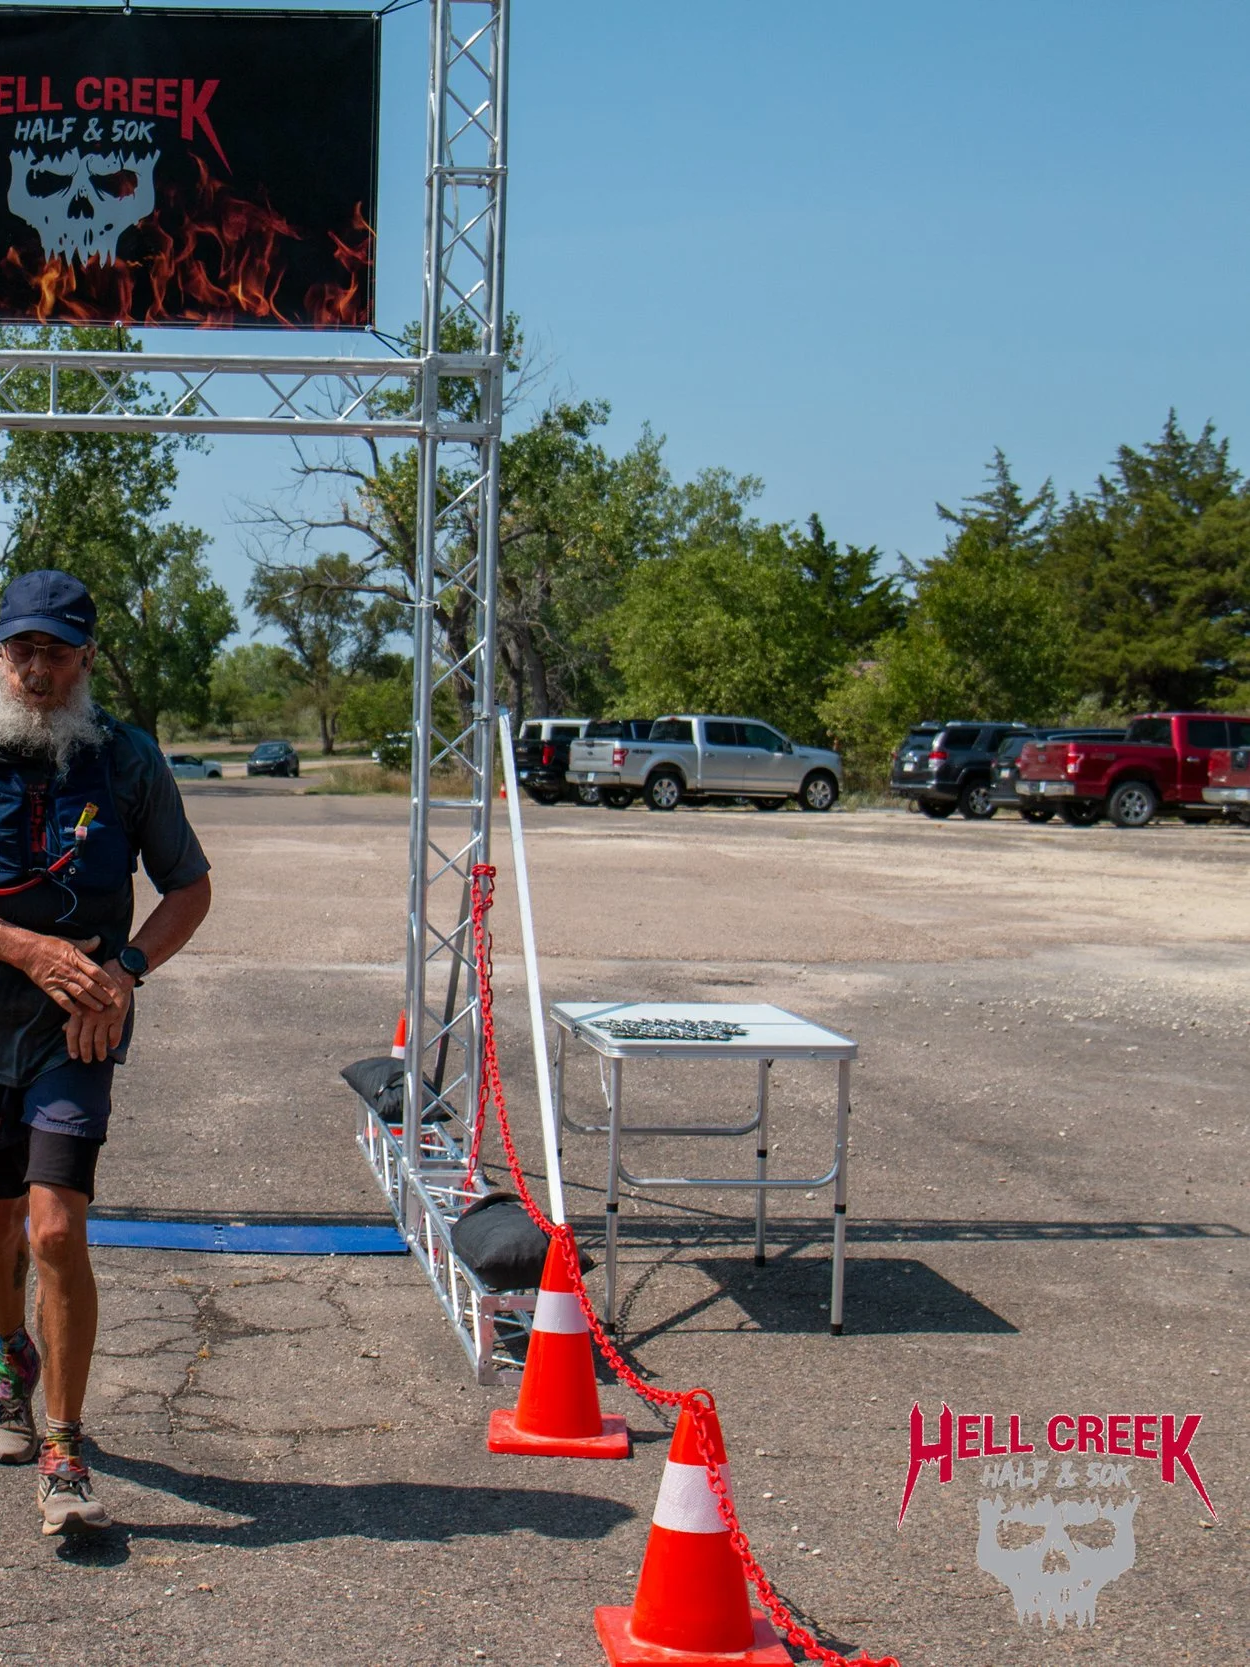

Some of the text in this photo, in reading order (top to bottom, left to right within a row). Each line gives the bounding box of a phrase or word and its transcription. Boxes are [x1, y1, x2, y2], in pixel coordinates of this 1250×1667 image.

[14, 117, 156, 144] HALF & 50K
[76, 77, 233, 176] CREEK
